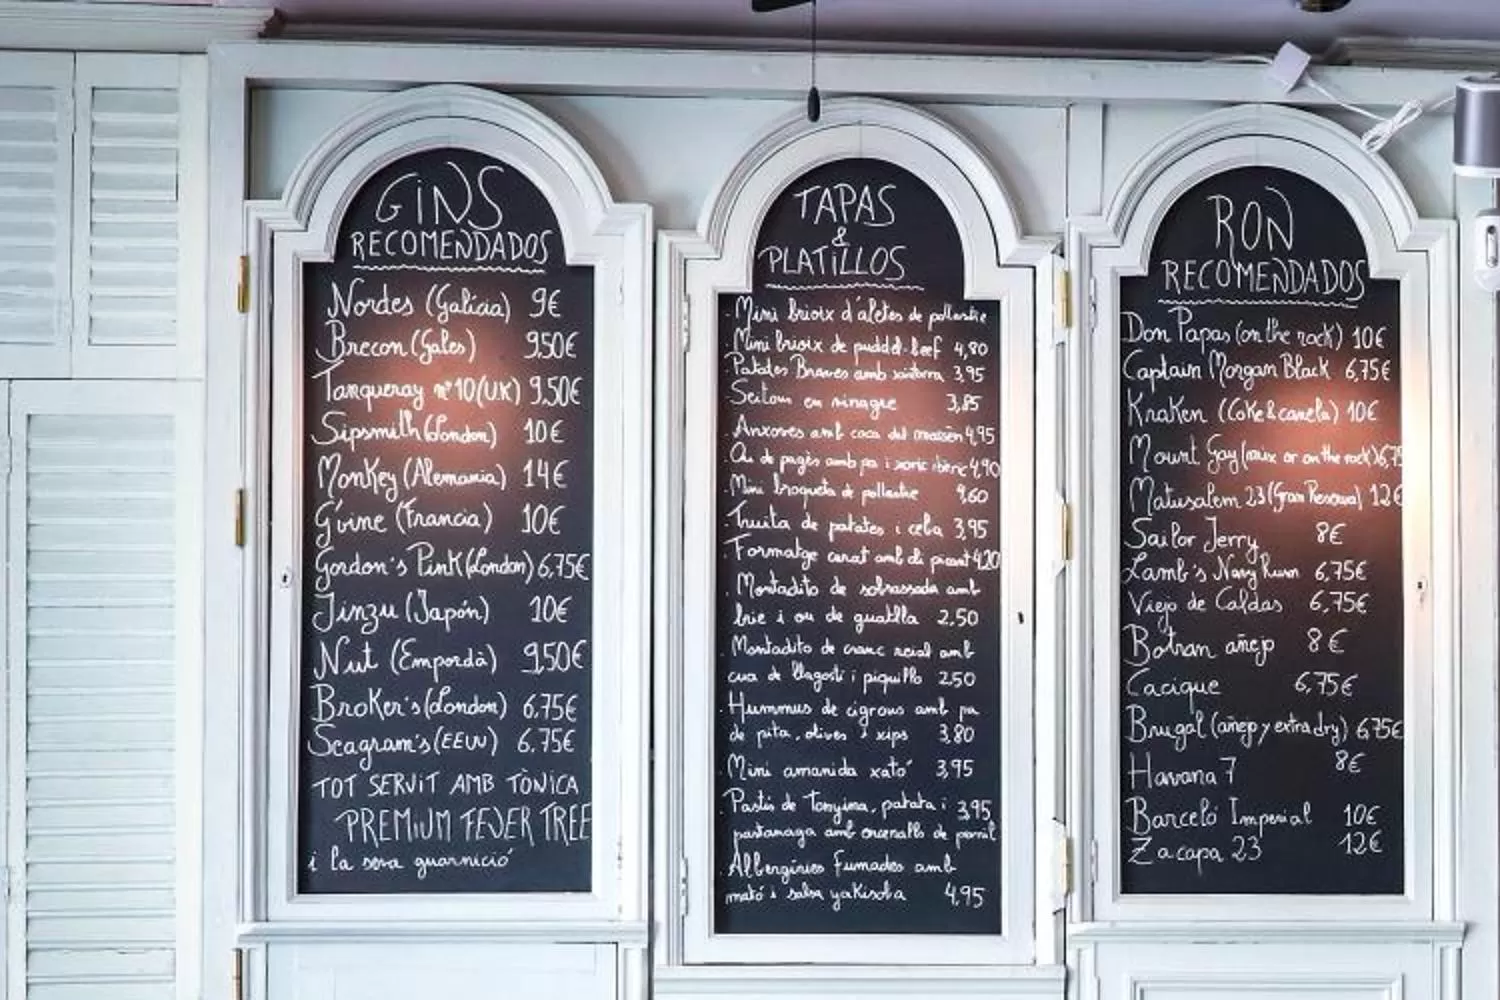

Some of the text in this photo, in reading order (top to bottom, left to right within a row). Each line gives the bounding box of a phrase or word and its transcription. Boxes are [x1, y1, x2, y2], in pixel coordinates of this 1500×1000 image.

[794, 182, 896, 227] TAPAS
[1207, 186, 1294, 260] RON
[351, 230, 552, 265] RECOMENDADOS
[831, 226, 848, 246] &
[328, 278, 414, 319] Nordes
[529, 287, 561, 318] 9€
[1161, 258, 1366, 301] RECOMENDADOS
[1121, 311, 1171, 344] Don
[1168, 306, 1231, 354] Papas
[1352, 326, 1387, 349] 10€
[312, 359, 424, 413] Tanqueray
[1122, 349, 1202, 392] Captain
[1208, 349, 1278, 390] Morgan
[524, 417, 565, 445] 10€
[1129, 433, 1200, 473] Mount
[523, 458, 570, 489] 14€
[1130, 476, 1242, 517] Matusalem
[520, 504, 566, 535] 10€
[802, 512, 819, 531] de
[1124, 516, 1347, 564] Sailor Jerry 8€
[830, 576, 847, 596] de
[530, 595, 573, 623] 10€
[826, 605, 843, 623] de
[1128, 590, 1178, 633] Viejo
[1187, 592, 1207, 612] de
[1215, 585, 1284, 614] Caldas
[313, 636, 379, 680] Nut
[1122, 623, 1217, 667] Botran
[728, 690, 812, 724] Hummus
[822, 697, 839, 716] de
[1126, 667, 1223, 714] Cacique
[1125, 703, 1208, 753] Brugal
[1274, 713, 1311, 734] extra
[311, 772, 495, 799] TOT AMB
[727, 753, 772, 781] Mini
[1127, 750, 1367, 790] Havana 7 8€
[459, 801, 593, 847] FEVER TREE
[1124, 796, 1381, 839] Barceló Imperial 10€
[331, 845, 355, 871] la
[1231, 835, 1263, 863] 23
[1337, 830, 1385, 856] 12€
